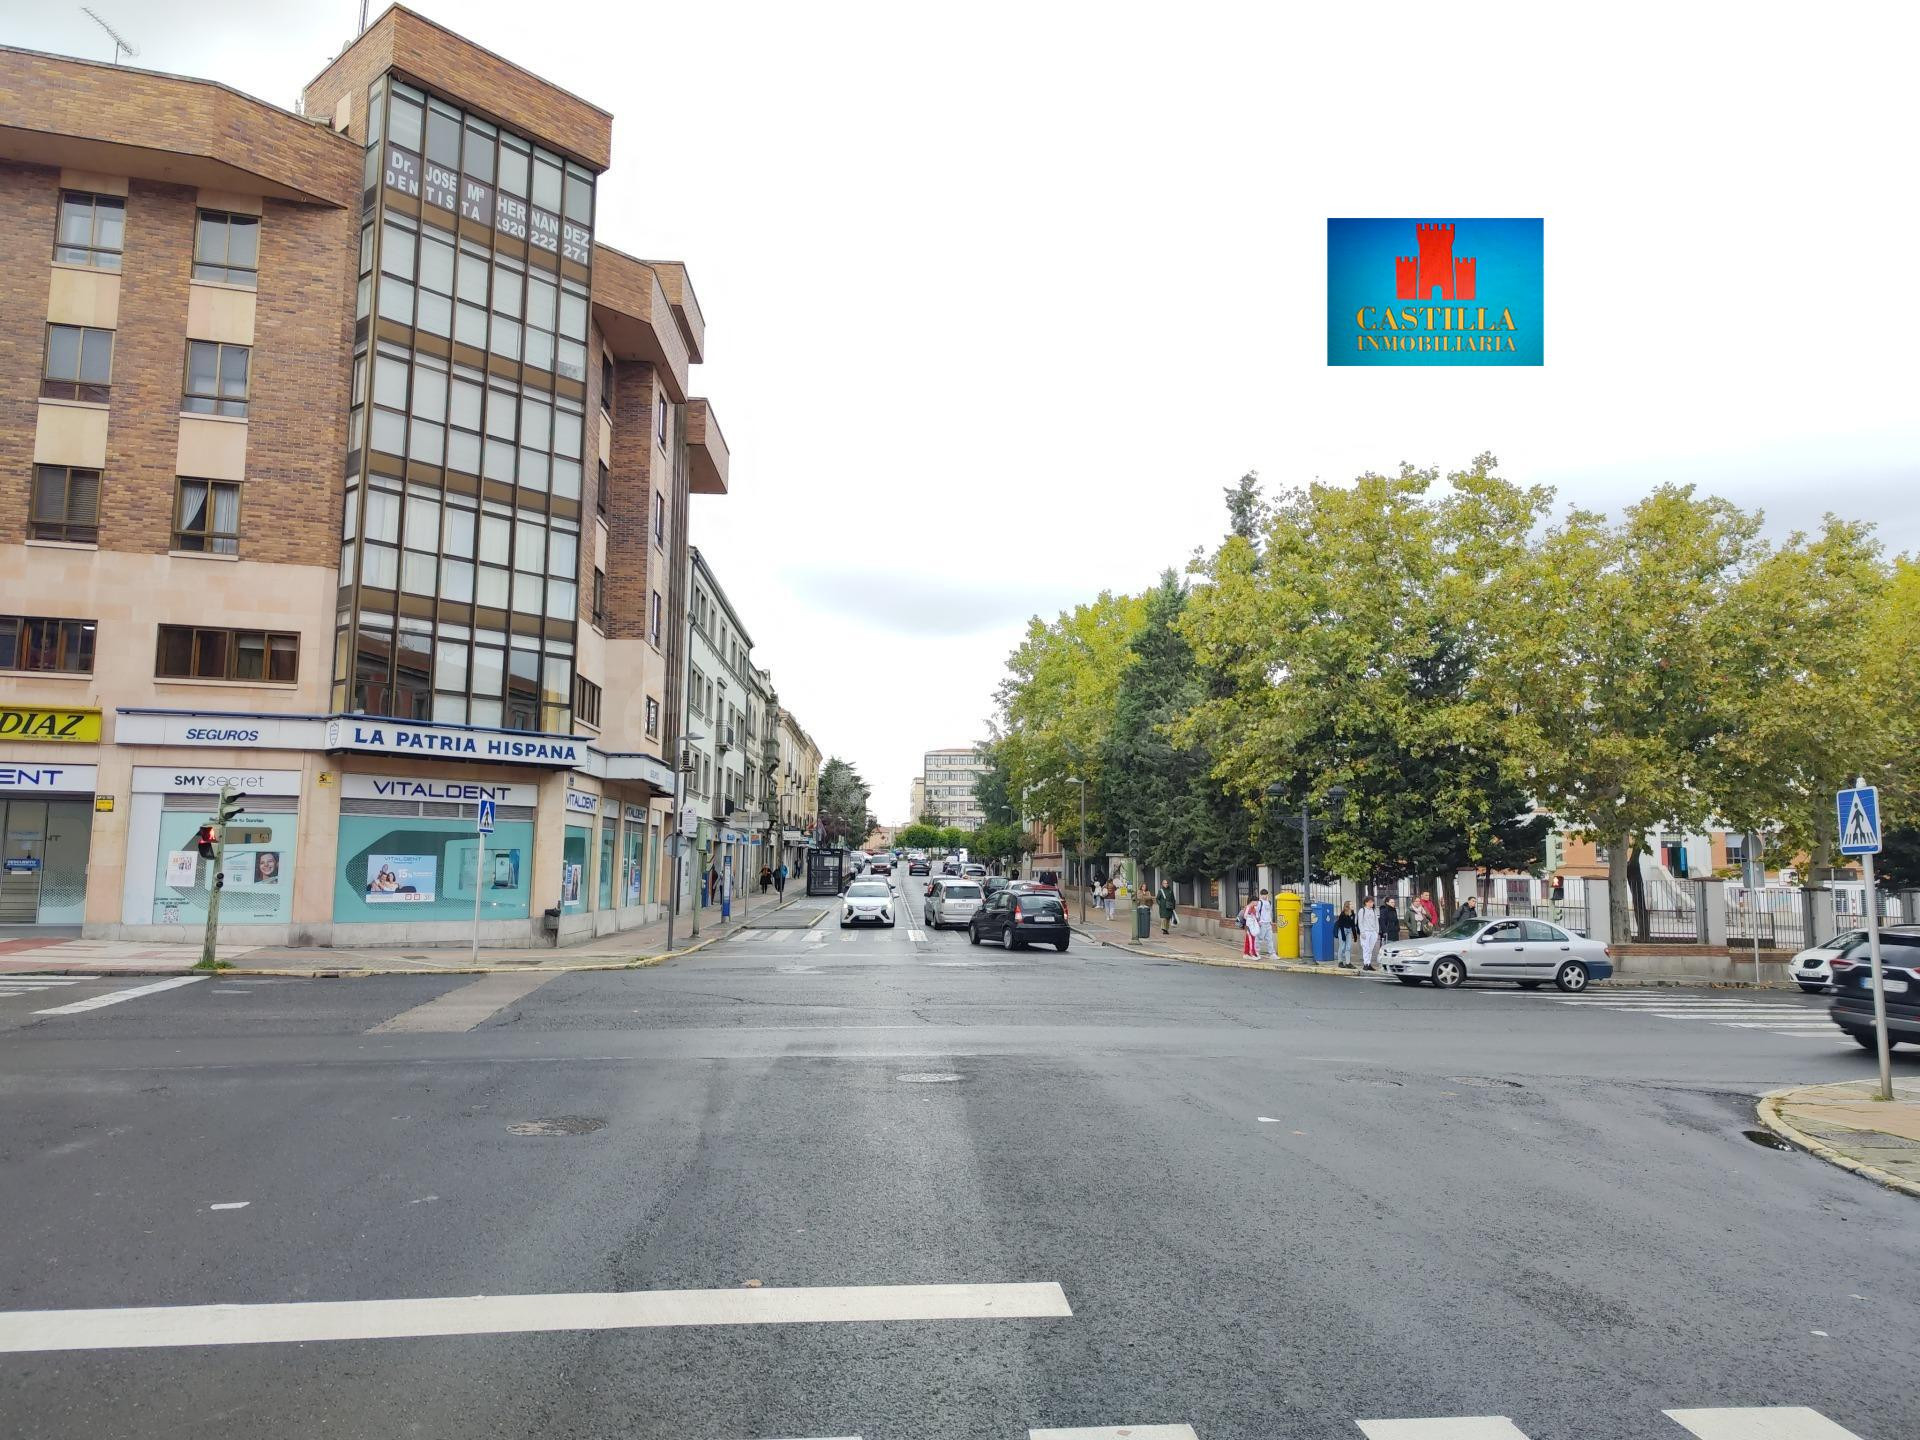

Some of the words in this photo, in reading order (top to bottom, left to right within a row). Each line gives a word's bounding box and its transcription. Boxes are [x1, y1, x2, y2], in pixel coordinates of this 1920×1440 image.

[391, 151, 414, 174] Dr.
[425, 166, 457, 193] JOSÉ
[186, 729, 259, 741] SEGUROS
[355, 728, 385, 745] LA
[396, 732, 477, 753] PATRIA
[488, 741, 577, 760] HISPANA
[373, 780, 512, 801] VITALDENT
[566, 793, 597, 810] VITALDENT
